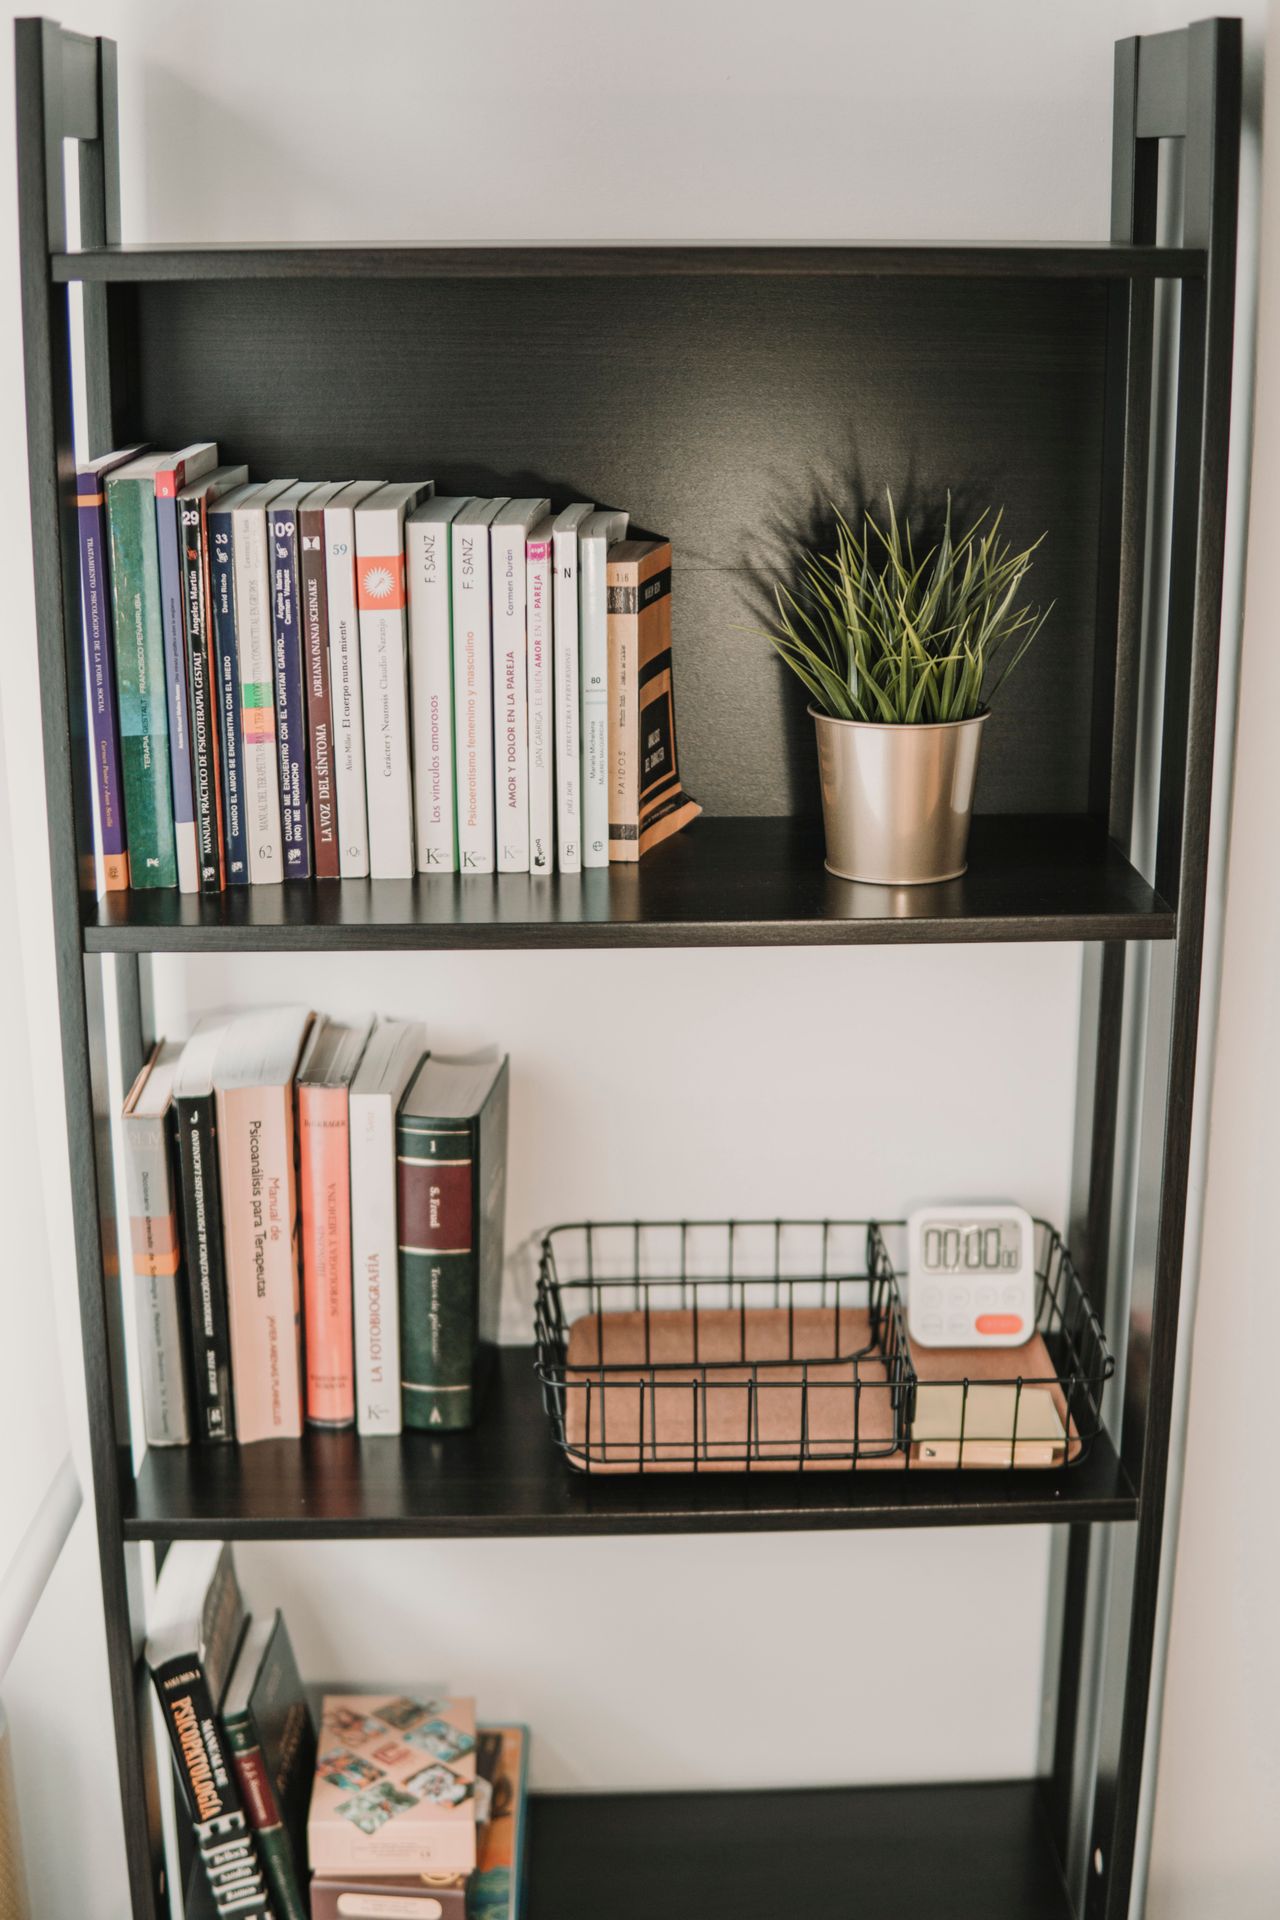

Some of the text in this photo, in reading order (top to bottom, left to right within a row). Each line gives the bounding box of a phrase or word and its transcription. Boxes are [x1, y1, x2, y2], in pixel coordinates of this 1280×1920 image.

[182, 510, 199, 526] 29
[268, 521, 295, 538] 109
[215, 533, 228, 545] 33
[332, 543, 348, 556] 59
[86, 537, 98, 589] TRATAMIENTO
[423, 535, 436, 584] F. SANZ
[461, 537, 473, 576] SANZ
[563, 567, 572, 579] N
[533, 574, 543, 609] PAREJA
[94, 640, 102, 652] DE
[339, 619, 348, 653] miente
[95, 653, 103, 663] LA
[136, 646, 146, 694] FRANCISCO
[341, 654, 349, 684] nunca
[464, 630, 475, 688] masculino
[533, 639, 542, 668] AMOR
[95, 664, 104, 687] FOBIA
[504, 549, 517, 809] AMOR Y DOLOR EN LA PAREJA Carmen Durán
[590, 675, 599, 685] 80
[97, 688, 106, 715] SOCIAL
[140, 697, 149, 734] GESTALT
[189, 570, 212, 854] MANUAL PRÁCTICO DE PSICOTERAPIA GESTALT Ángeles Martín
[219, 572, 239, 836] CUANDO EL AMOR SE ENCUENTRA CON EL MIEDO David Richo
[280, 708, 288, 720] EL
[308, 578, 332, 843] LA VOZ DEL SÍNTOMA ADRIANA (NANA) SCHNAKE
[342, 685, 351, 717] cuerpo
[380, 694, 390, 732] Neurosis
[280, 722, 289, 740] CON
[341, 718, 351, 729] El
[430, 694, 440, 752] amorosos
[465, 698, 477, 748] femenino
[142, 735, 151, 769] TERAPIA
[281, 743, 292, 791] ENCUENTRO
[383, 740, 392, 777] Carácter
[284, 793, 292, 807] ME
[291, 762, 303, 842] (NO) ME ENGANCHO
[466, 751, 478, 827] Psicoerotismo
[284, 808, 294, 841] CUANDO
[429, 805, 441, 824] Los
[258, 845, 273, 859] 62
[249, 1120, 268, 1298] Psicoanálisis para Terapeutas
[269, 1177, 283, 1242] Manual de
[429, 1185, 441, 1229] S. Freud
[370, 1366, 383, 1383] LA
[170, 1694, 225, 1822] PSICOPATOLOGÍA
